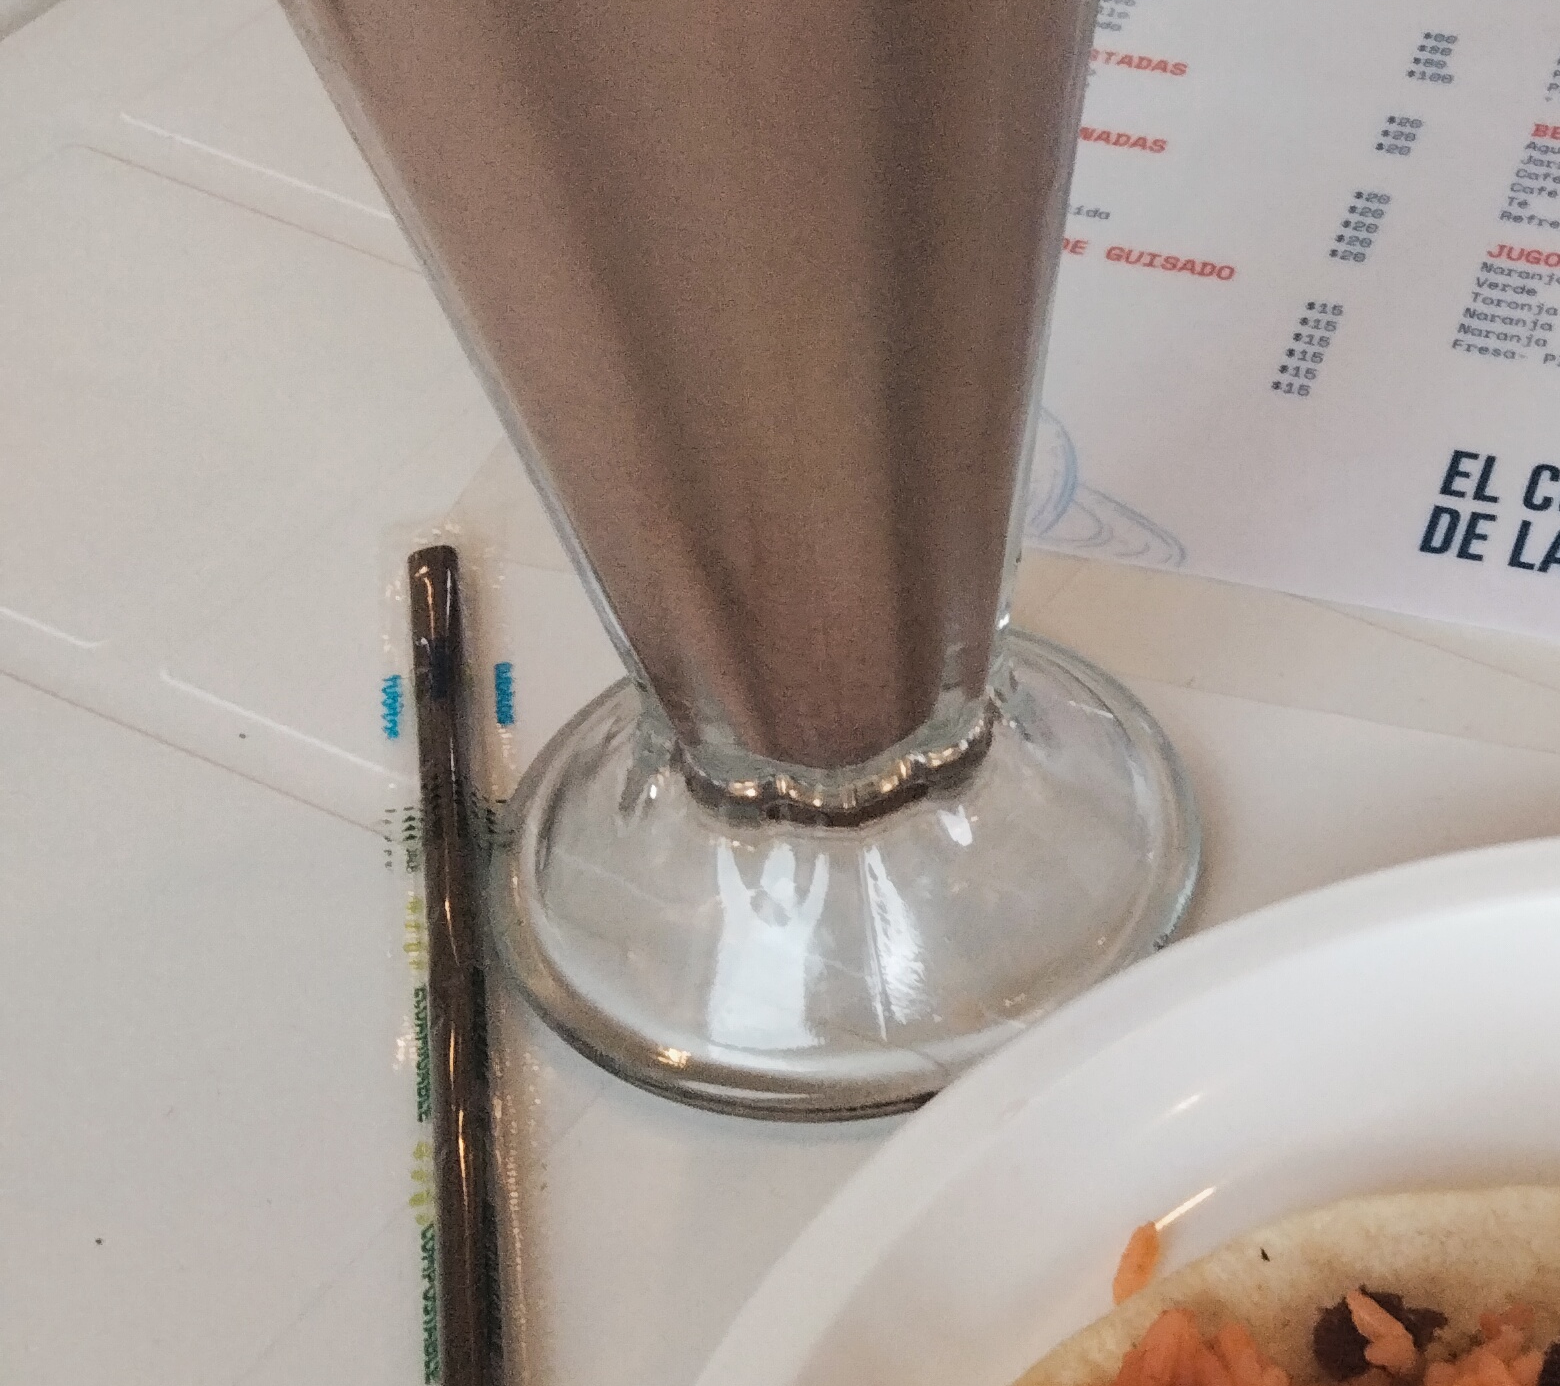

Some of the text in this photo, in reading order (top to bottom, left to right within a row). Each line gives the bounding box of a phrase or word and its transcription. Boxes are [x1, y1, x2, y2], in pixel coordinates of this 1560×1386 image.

[1104, 245, 1237, 281] GUISADO
[1475, 277, 1537, 296] Verde
[1305, 301, 1343, 317] $15
[1472, 291, 1558, 316] Toronja
[1298, 317, 1338, 333] $15
[1462, 307, 1553, 332] Naranja
[1292, 332, 1330, 348] $15
[1457, 323, 1547, 347] Naranja
[1285, 348, 1324, 364] $15
[1278, 364, 1318, 381] $15
[1271, 380, 1311, 397] $15
[1439, 449, 1499, 504] EL
[1418, 504, 1497, 563] DE
